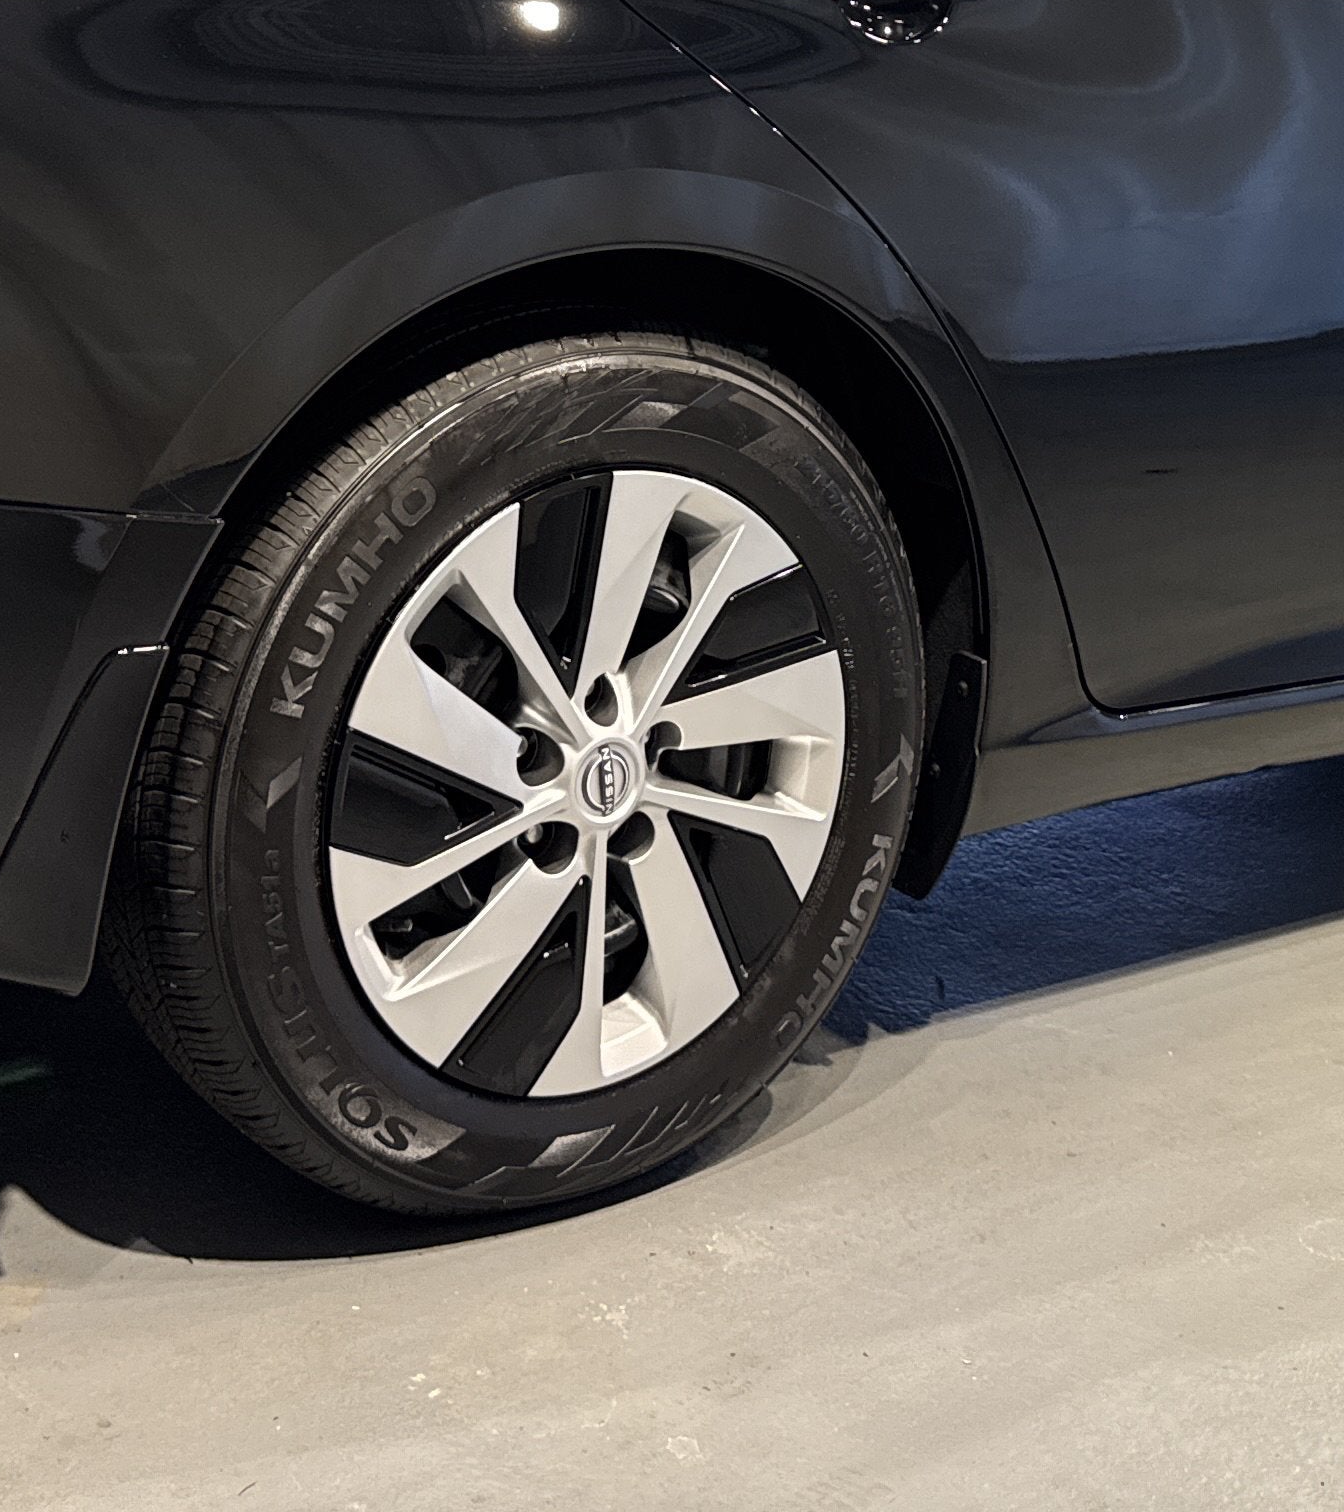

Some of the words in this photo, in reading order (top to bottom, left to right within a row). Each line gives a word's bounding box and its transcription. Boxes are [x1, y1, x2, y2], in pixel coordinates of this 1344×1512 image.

[269, 475, 438, 720] KUMHO
[600, 746, 614, 815] NISSAN
[772, 833, 894, 1048] KUMHO
